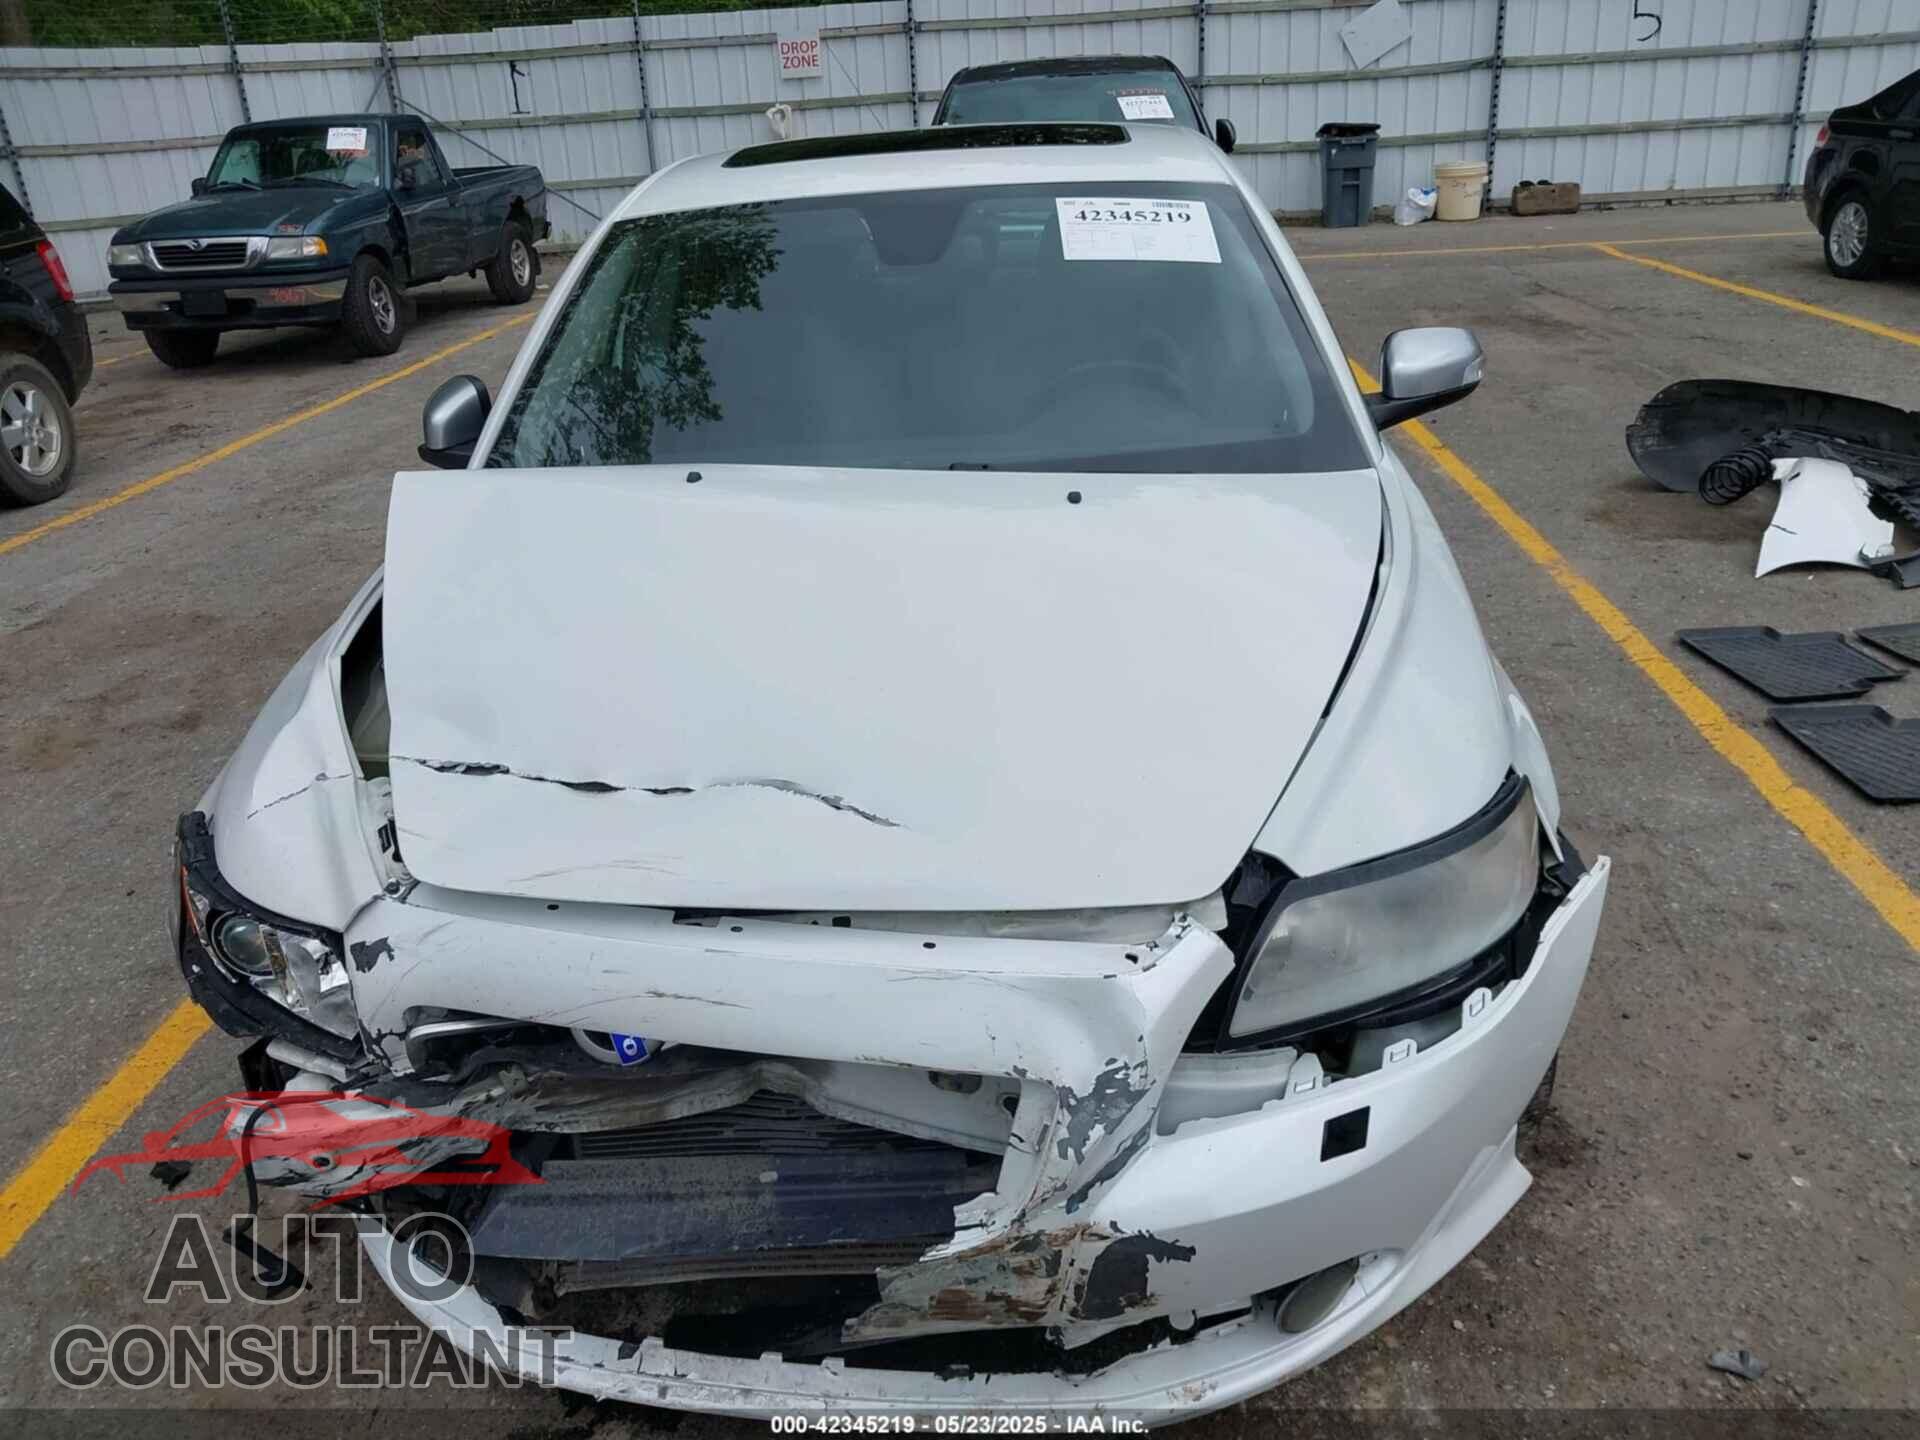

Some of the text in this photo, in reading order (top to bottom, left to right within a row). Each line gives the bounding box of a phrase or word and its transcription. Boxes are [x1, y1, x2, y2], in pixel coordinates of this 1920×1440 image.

[1633, 0, 1662, 41] 5
[780, 40, 818, 54] DROP
[783, 54, 819, 69] ZONE
[1074, 210, 1192, 223] 42345219
